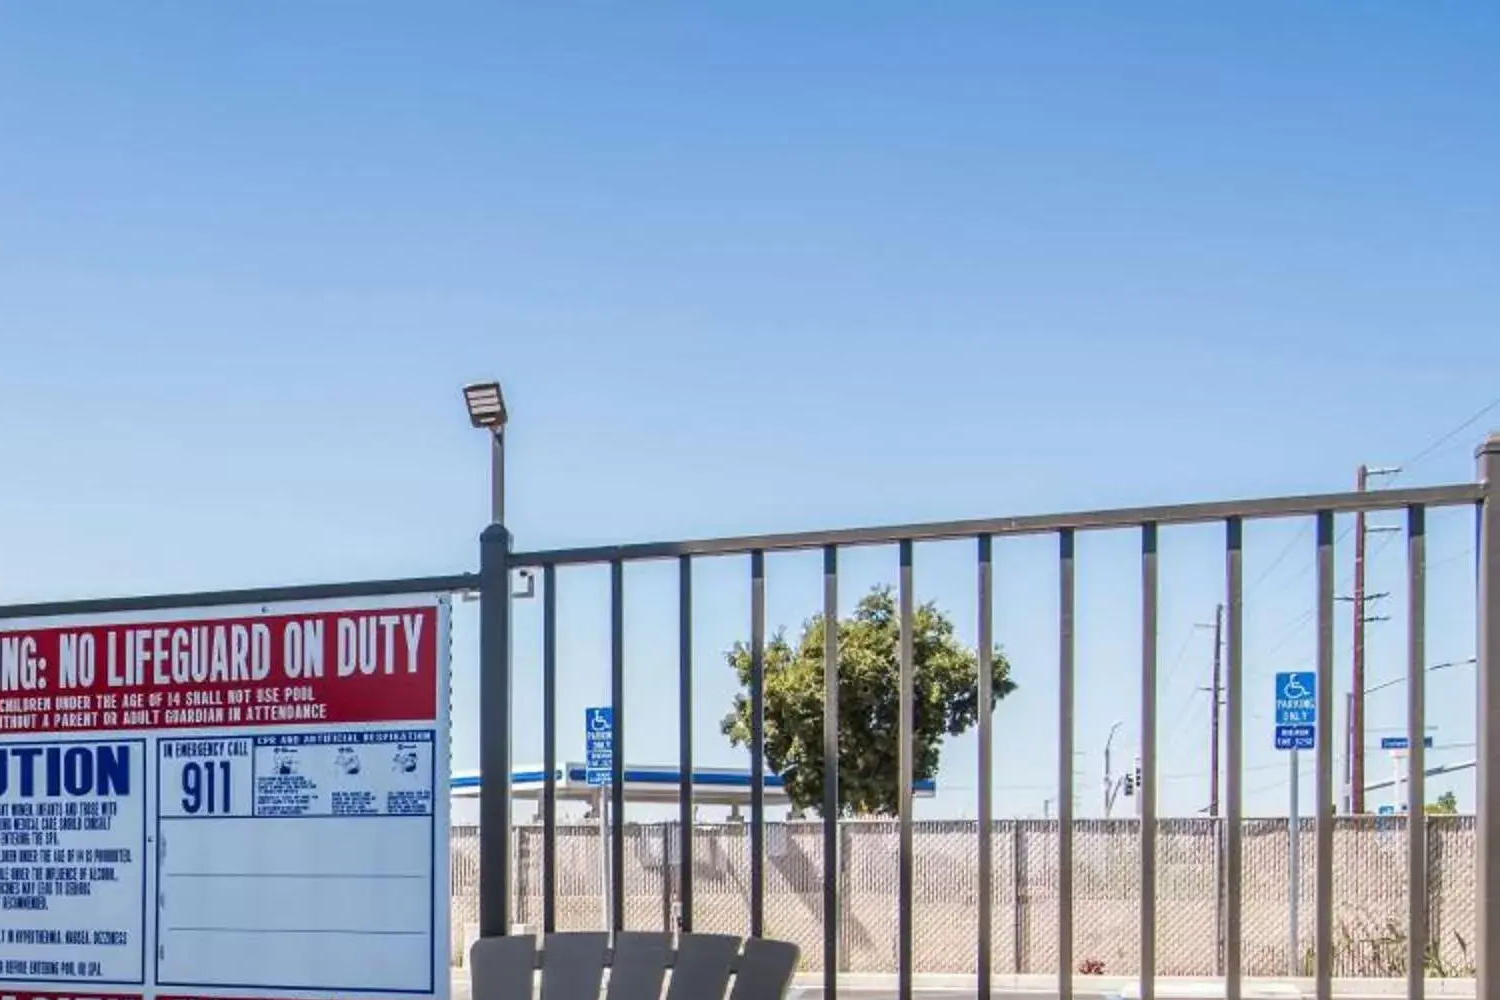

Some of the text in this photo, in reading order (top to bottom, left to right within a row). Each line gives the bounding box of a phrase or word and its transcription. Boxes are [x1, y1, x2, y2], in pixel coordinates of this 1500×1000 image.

[59, 632, 96, 689] NO
[107, 622, 271, 687] LIFEGUARD
[283, 618, 324, 680] ON
[337, 613, 424, 678] DUTY
[0, 686, 316, 712] CHILDREN UNDER THE AGE OF 14 SHALL NOT USE POOL
[42, 713, 50, 727] A
[54, 711, 98, 727] PARENT
[103, 711, 117, 725] OR
[122, 709, 160, 725] ADULT
[165, 707, 224, 724] GUARDIAN
[228, 706, 240, 721] IN
[245, 703, 327, 721] ATTENDANCE
[163, 740, 248, 758] IN EMERGENCY CALL
[181, 760, 231, 814] 911
